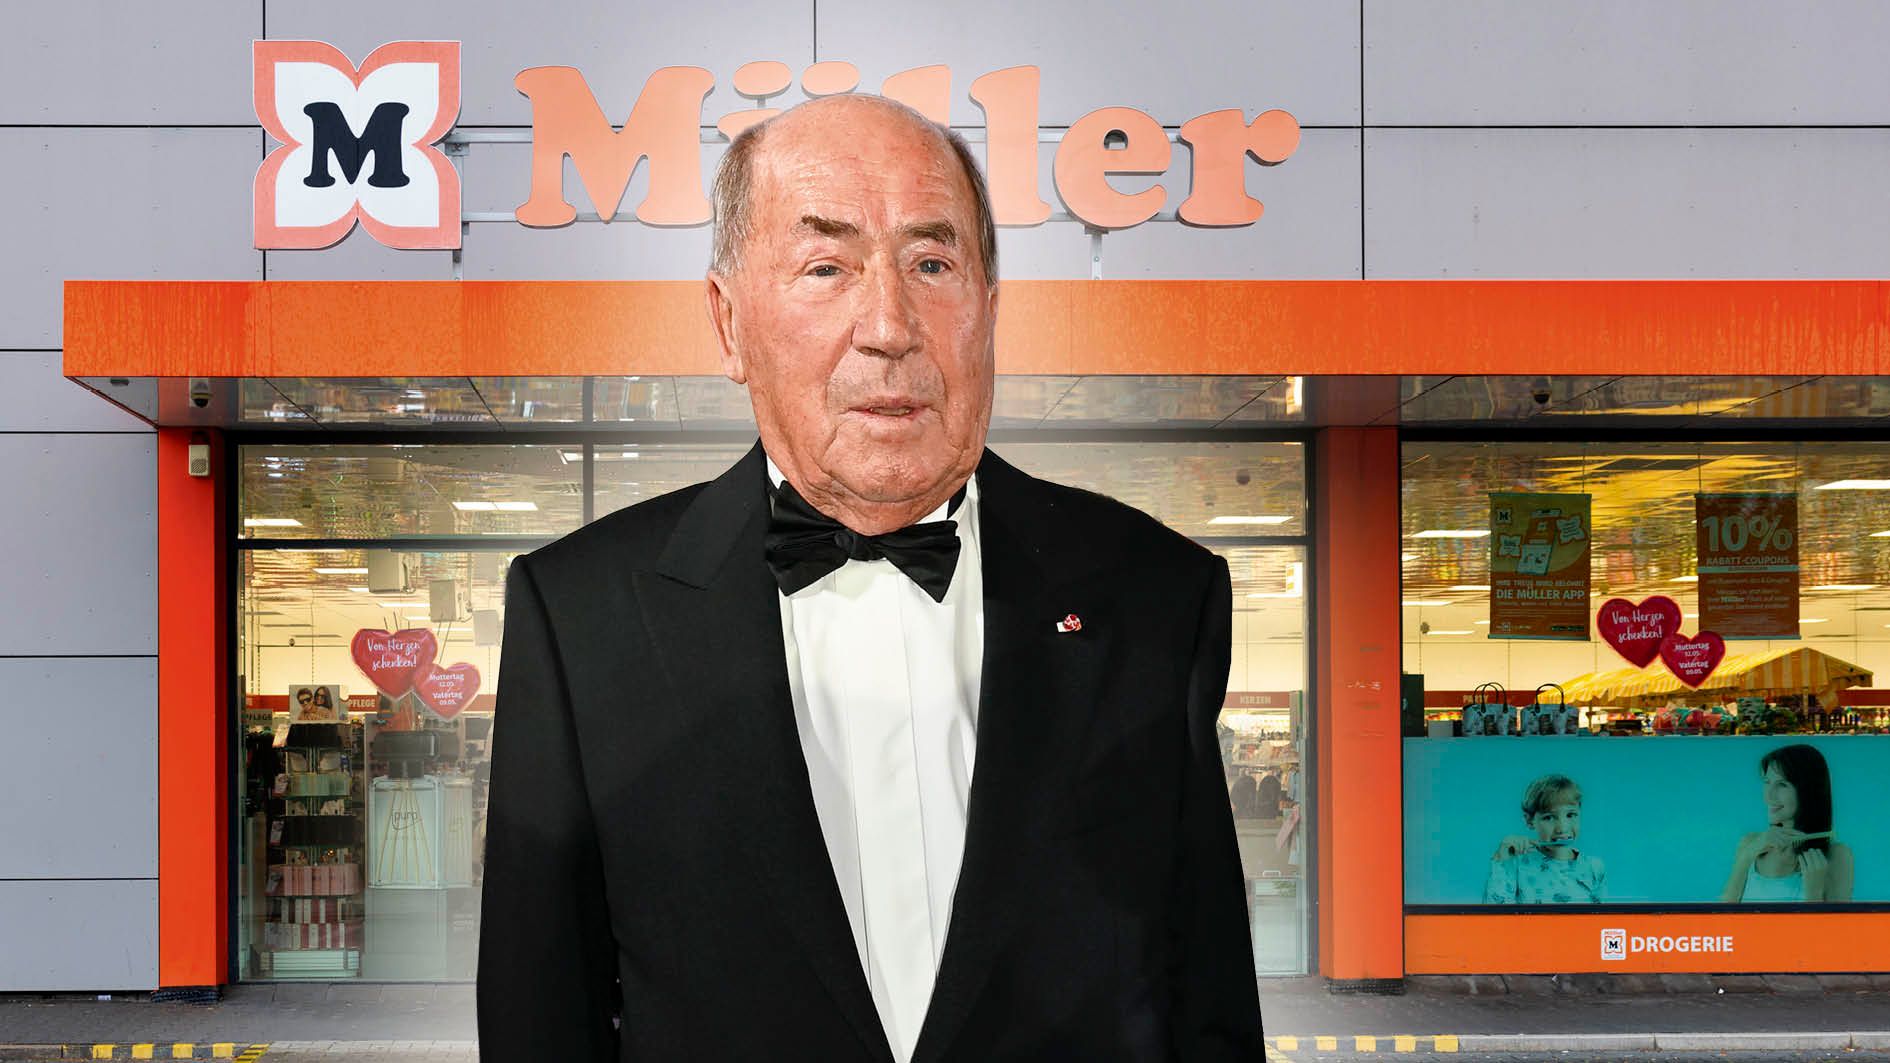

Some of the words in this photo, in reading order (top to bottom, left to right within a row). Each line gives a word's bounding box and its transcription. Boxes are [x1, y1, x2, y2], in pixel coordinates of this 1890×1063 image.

[303, 102, 409, 188] M
[1702, 514, 1793, 552] 10%
[1496, 589, 1513, 599] DIE
[1517, 586, 1560, 600] MÜLLER
[1563, 590, 1585, 600] APP
[1612, 611, 1630, 625] Von
[1632, 609, 1665, 627] Herzen
[1618, 625, 1662, 643] schenken!
[367, 639, 384, 652] Von
[388, 639, 420, 656] Herzen
[372, 655, 417, 672] schenken!
[348, 699, 376, 708] PFLEGE
[1631, 936, 1734, 953] DROGERIE
